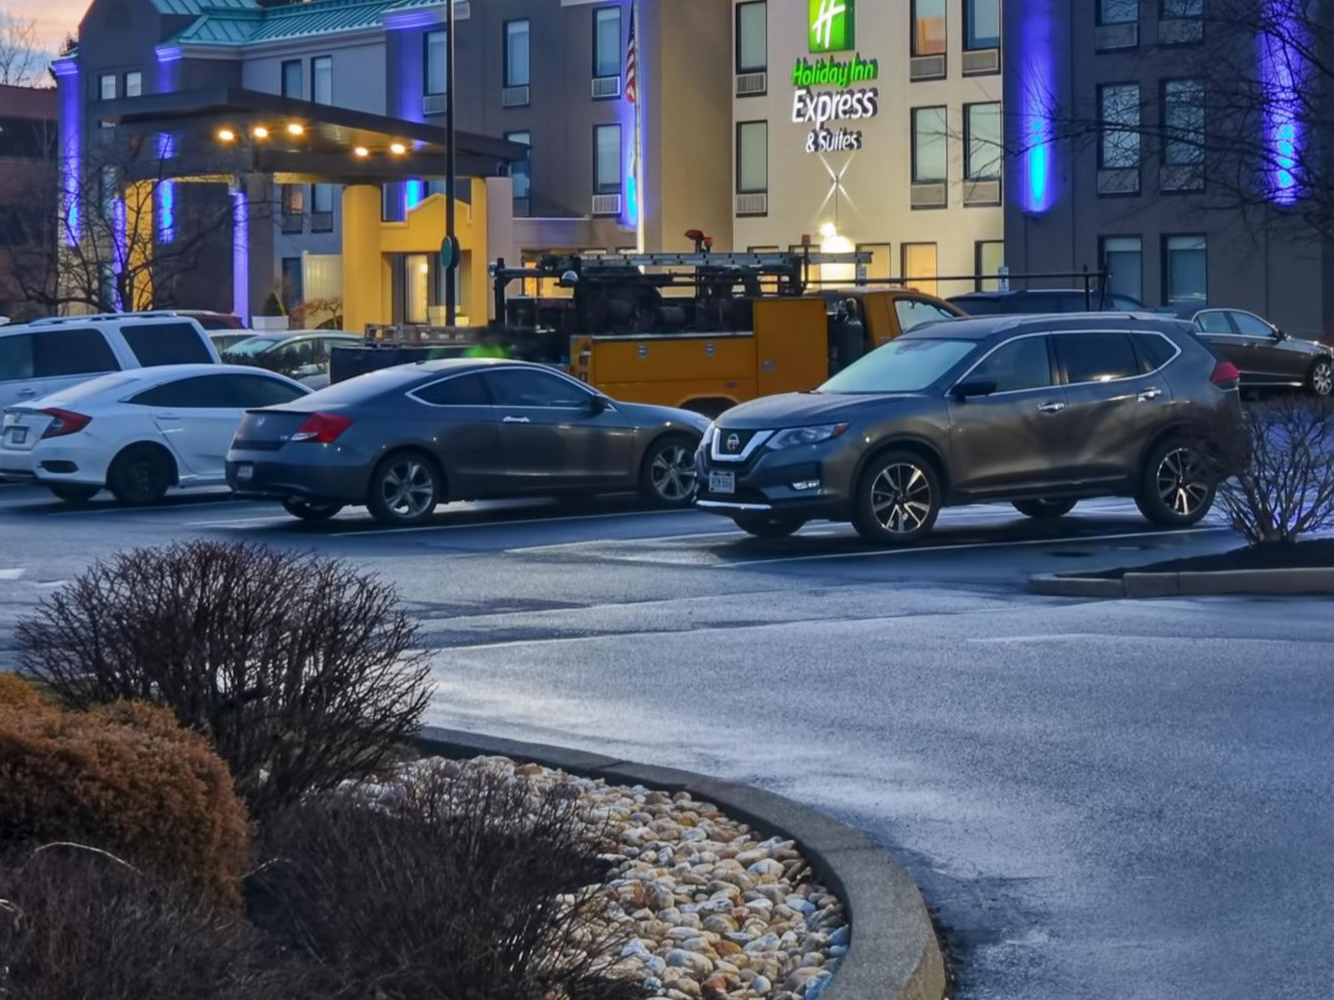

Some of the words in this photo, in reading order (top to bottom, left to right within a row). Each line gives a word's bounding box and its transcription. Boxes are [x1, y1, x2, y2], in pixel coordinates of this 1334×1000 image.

[791, 59, 849, 88] Holiday
[849, 55, 875, 82] Inn
[791, 89, 875, 131] Express
[805, 131, 816, 153] &
[818, 129, 859, 151] Suites
